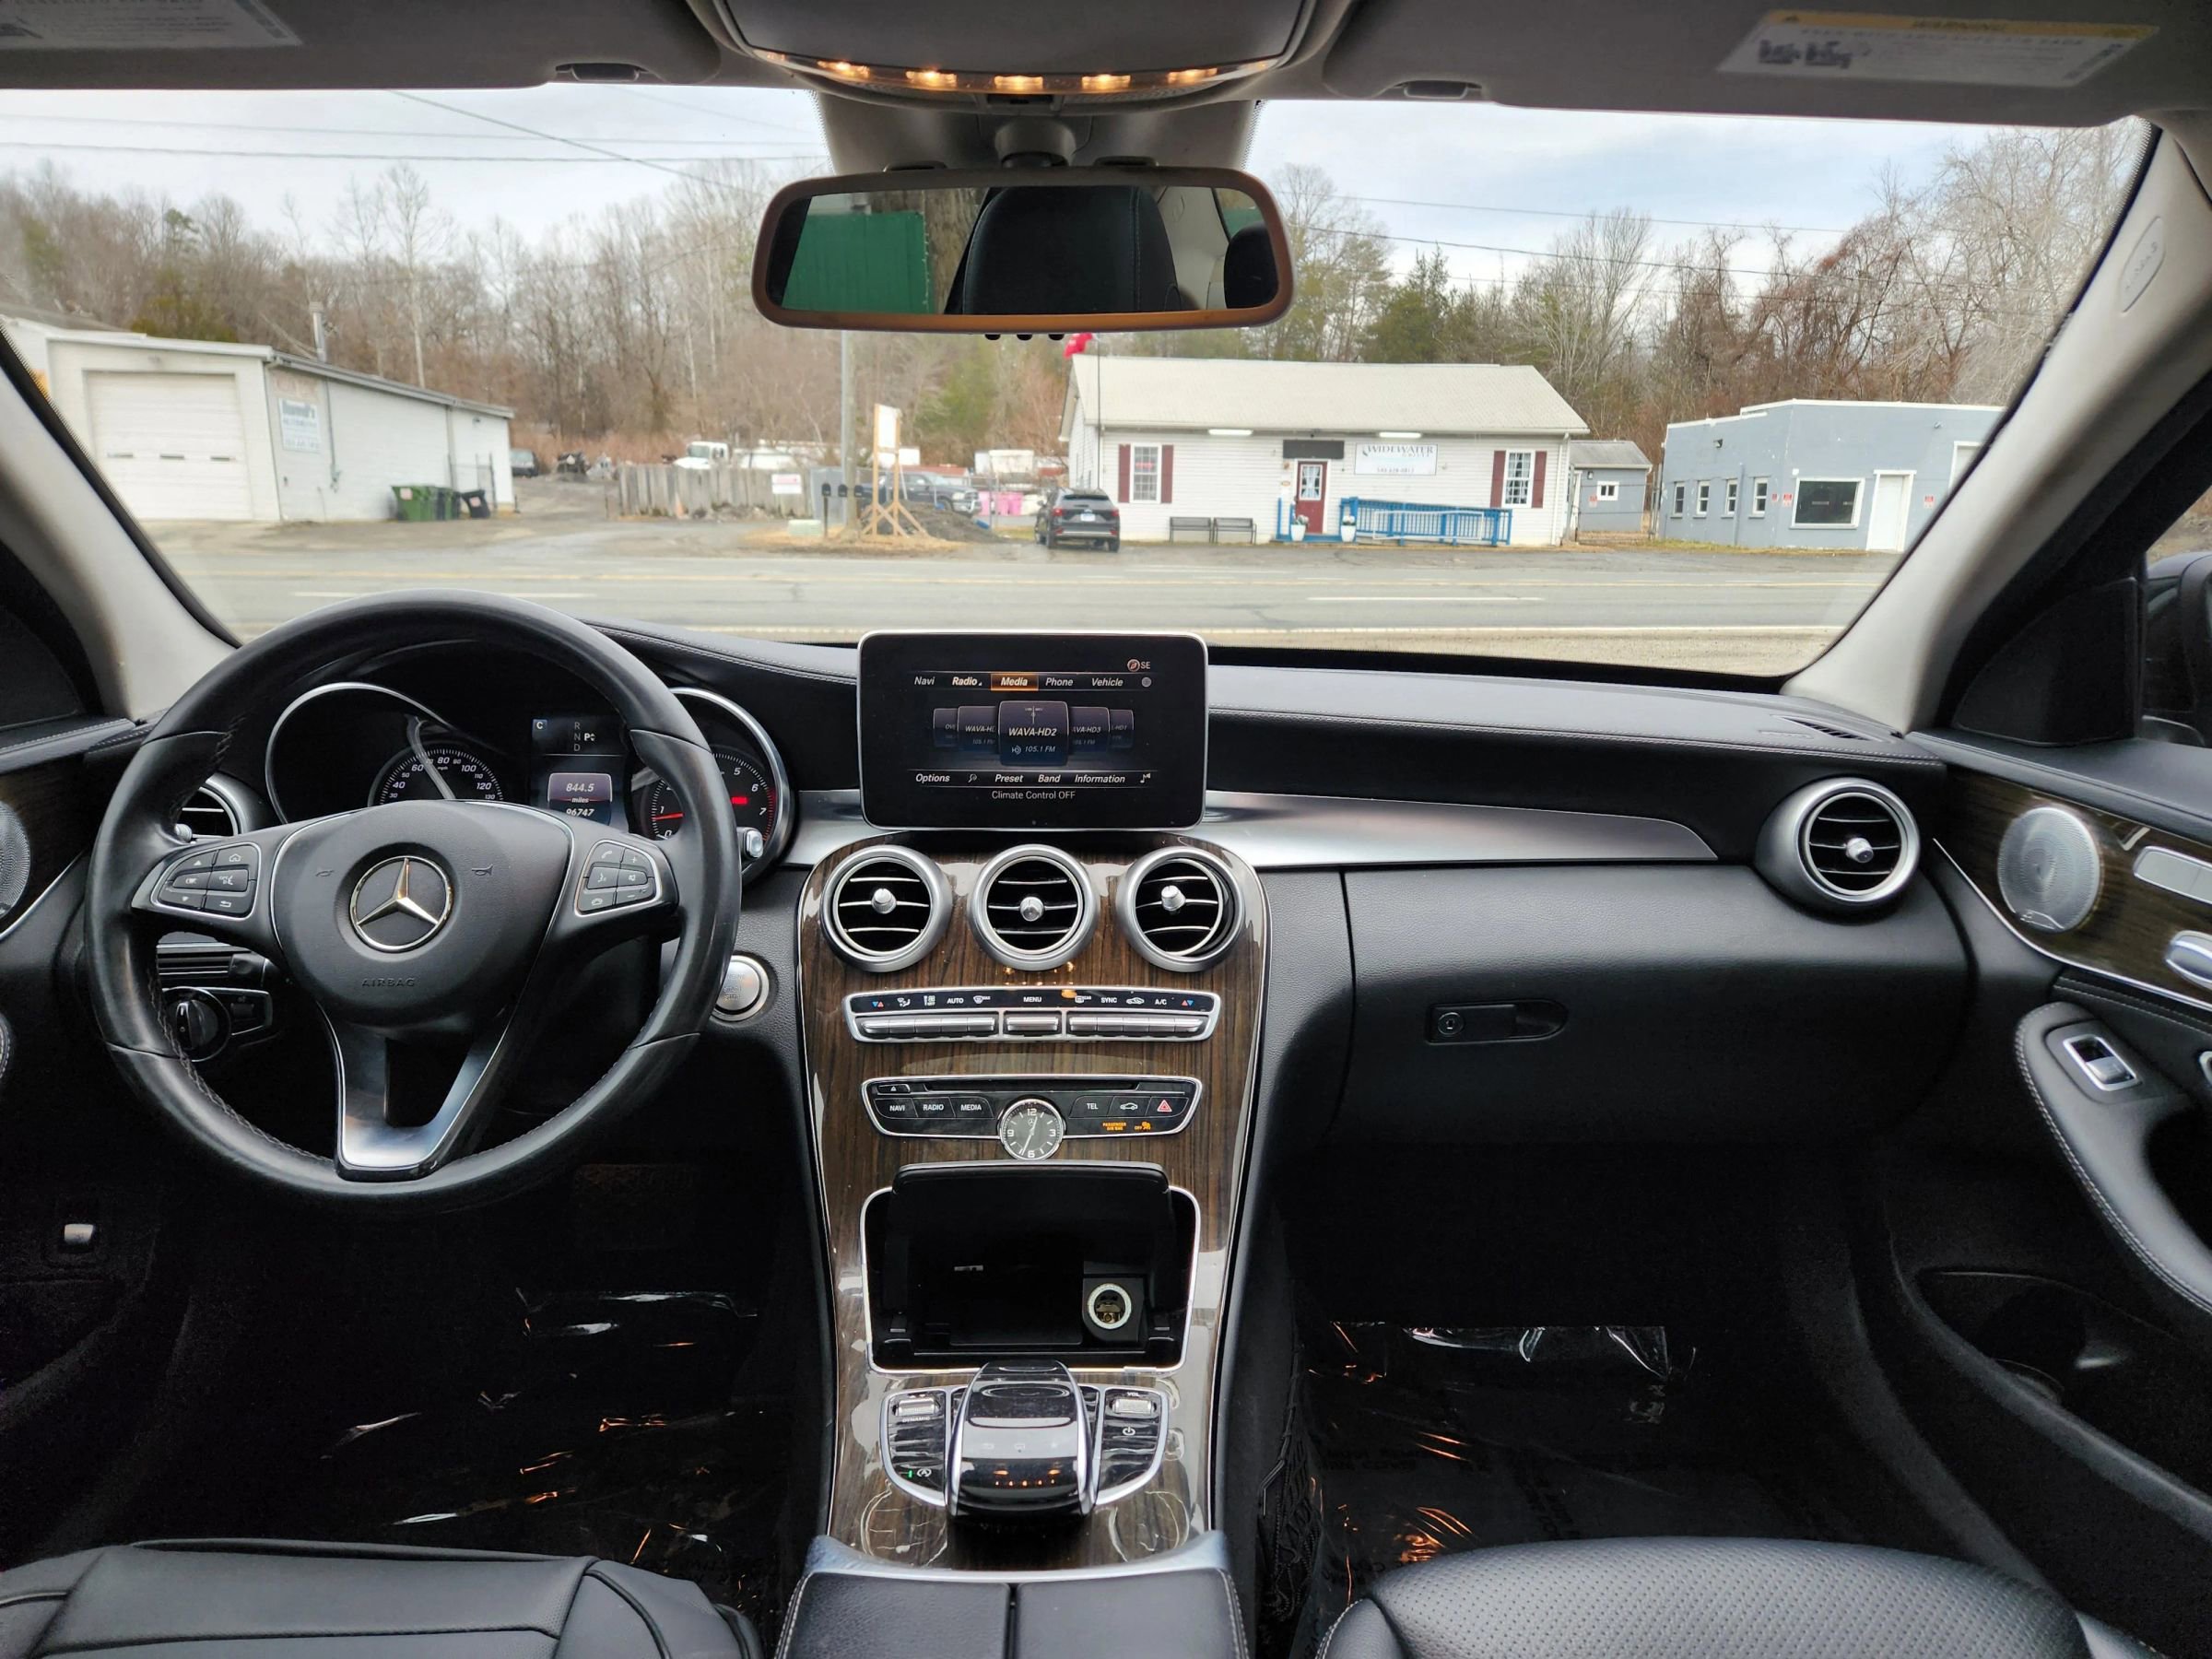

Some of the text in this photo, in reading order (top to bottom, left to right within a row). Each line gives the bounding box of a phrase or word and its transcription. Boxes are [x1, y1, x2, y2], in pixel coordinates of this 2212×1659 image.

[1140, 661, 1151, 670] SE
[914, 677, 935, 686] Navi
[952, 677, 978, 687] Radio
[1001, 677, 1029, 687] Media
[1045, 677, 1074, 688] Phone
[1091, 677, 1124, 688] Vehicle
[574, 722, 581, 730] R
[1008, 726, 1057, 736] WAVA-HD2
[573, 733, 581, 741] N
[583, 733, 591, 741] P
[573, 743, 581, 751] D
[1025, 745, 1056, 753] 105.1 FM
[916, 773, 950, 784] Options
[995, 773, 1023, 782] Preset
[1038, 774, 1061, 783] Band
[1075, 774, 1125, 783] Information
[566, 783, 594, 792] 844.5
[751, 783, 759, 792] 6
[992, 791, 1077, 800] Climate Control OFF
[566, 808, 594, 817] 96747
[759, 807, 767, 816] 7
[362, 978, 415, 987] AIRBAG
[1027, 1108, 1037, 1116] 12
[1007, 1129, 1014, 1137] 9
[1049, 1128, 1056, 1136] 3
